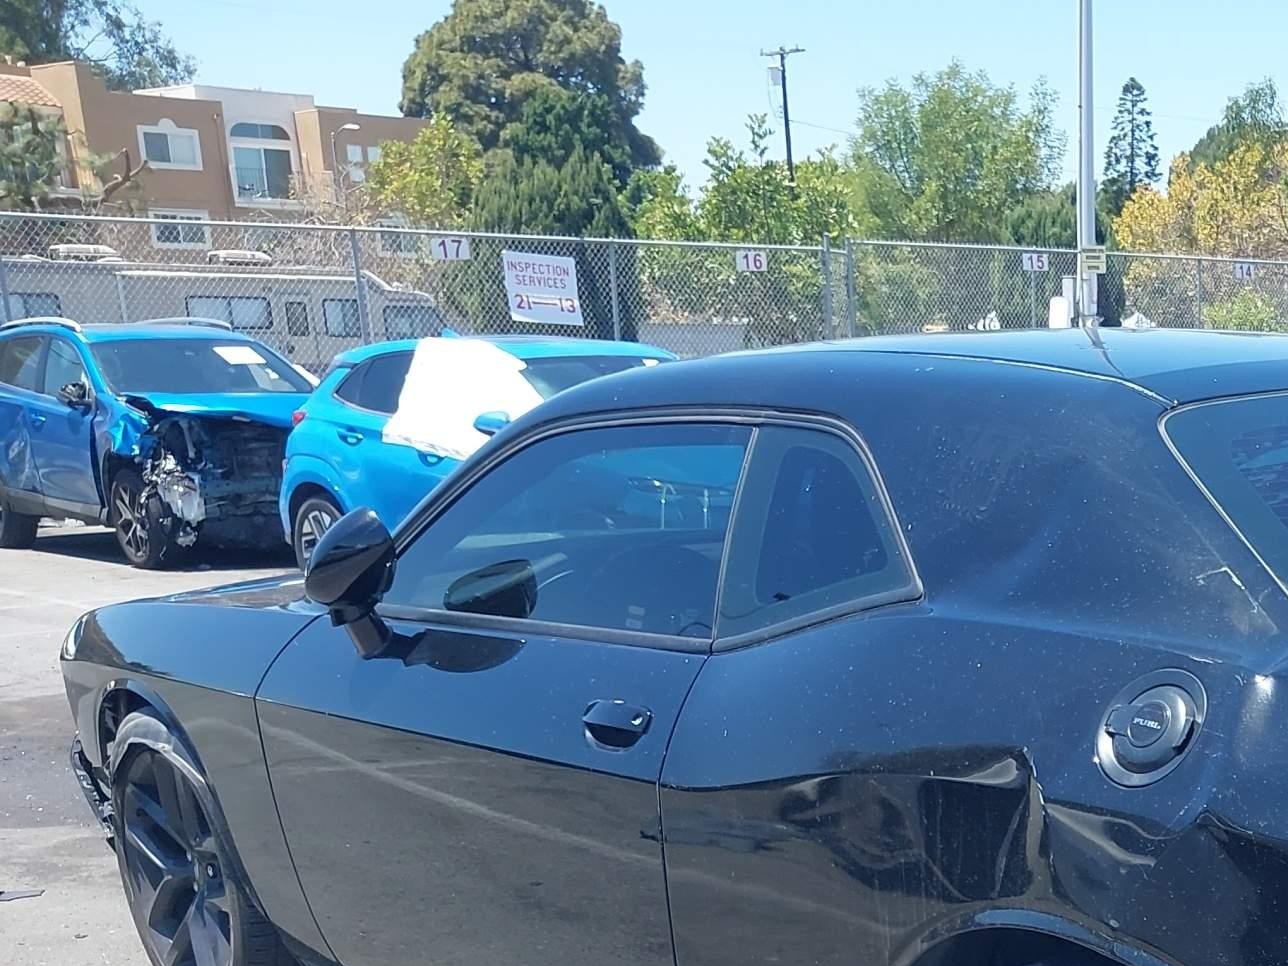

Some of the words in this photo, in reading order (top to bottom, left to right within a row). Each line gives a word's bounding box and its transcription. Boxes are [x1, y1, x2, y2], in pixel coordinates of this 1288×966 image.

[438, 240, 462, 259] 17
[507, 260, 570, 277] INSPECTION
[742, 253, 763, 270] 16
[1027, 254, 1045, 270] 15
[515, 274, 567, 290] SERVICES
[1132, 717, 1162, 730] FUEL
